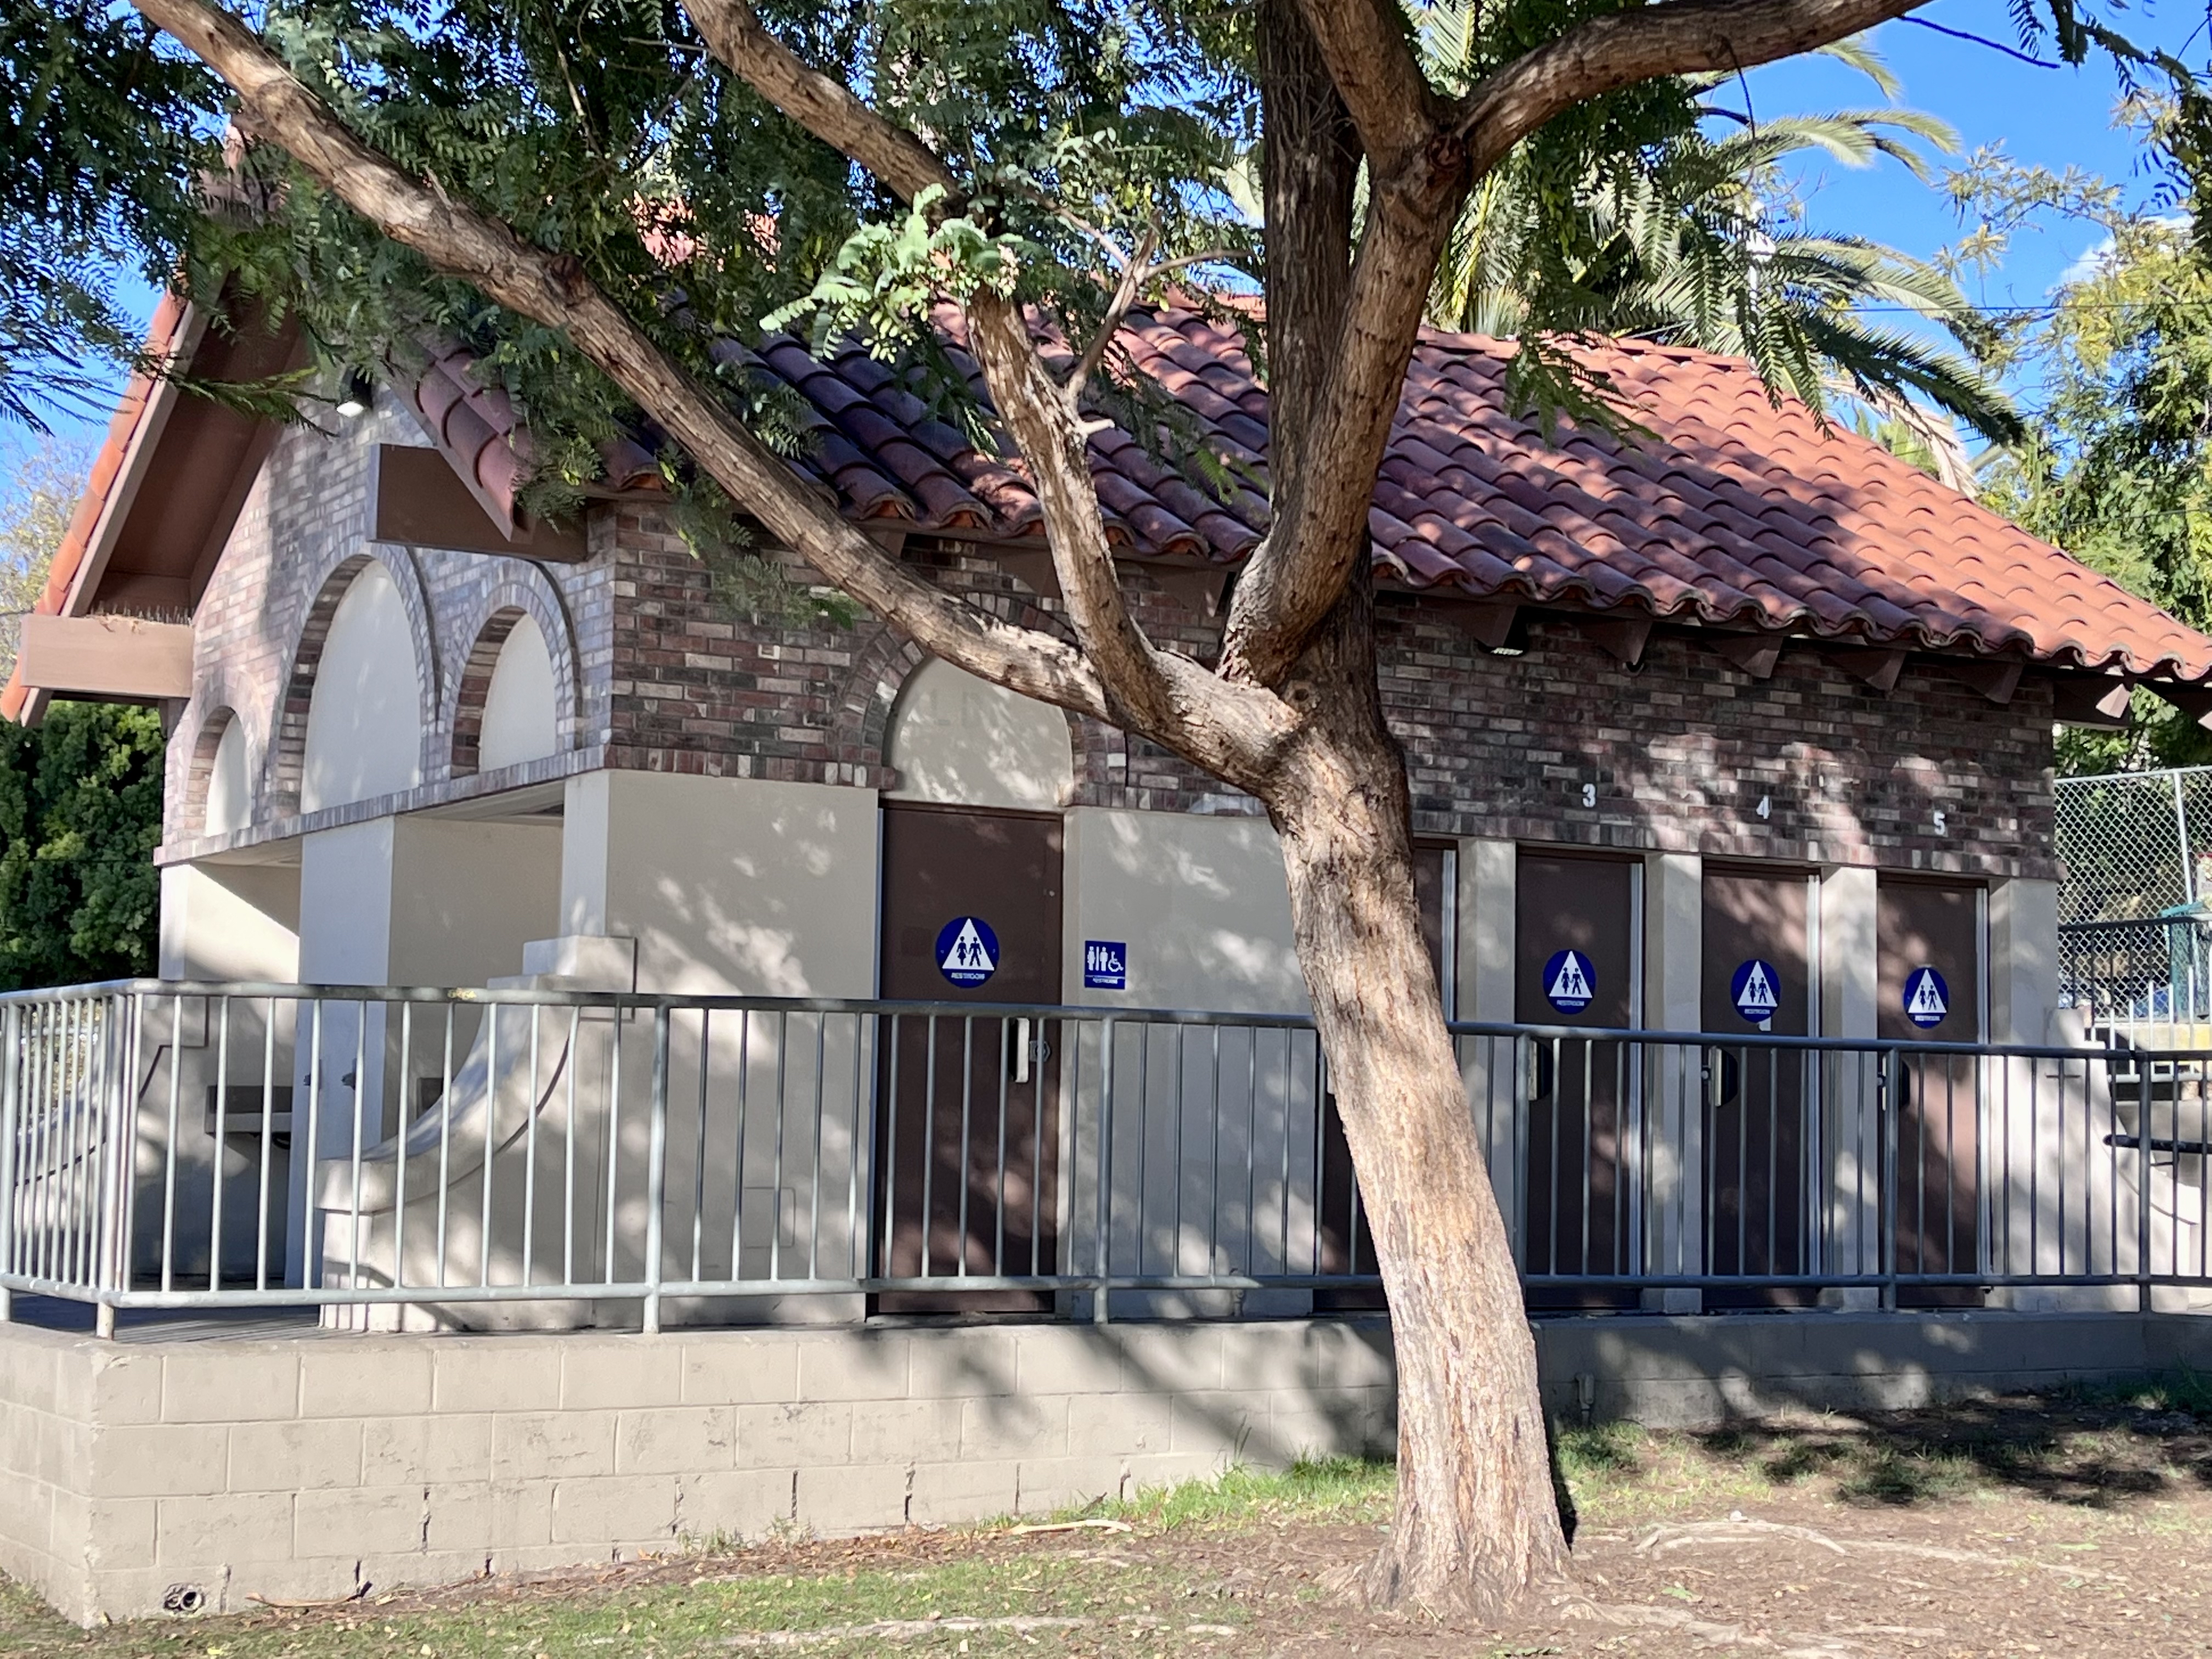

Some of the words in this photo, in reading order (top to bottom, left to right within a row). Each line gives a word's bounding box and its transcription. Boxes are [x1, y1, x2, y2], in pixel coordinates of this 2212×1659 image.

[1582, 783, 1596, 808] 3
[1756, 795, 1770, 819] 4
[1933, 810, 1945, 835] 5
